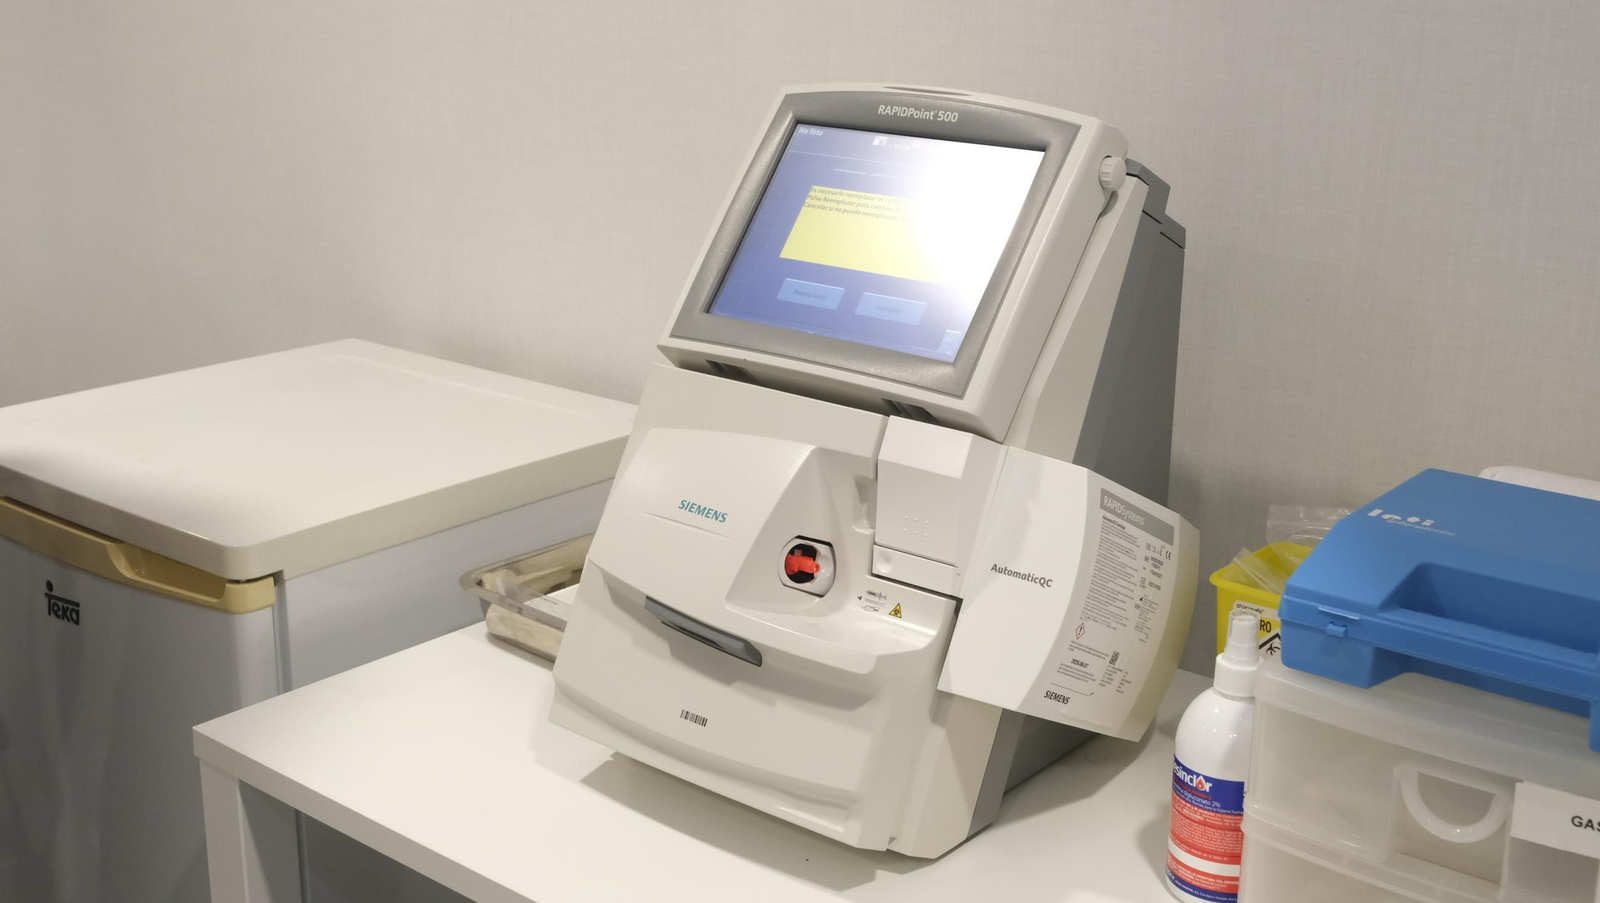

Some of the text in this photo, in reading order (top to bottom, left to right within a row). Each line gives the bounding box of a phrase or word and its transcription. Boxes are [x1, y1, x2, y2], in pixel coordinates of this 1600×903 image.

[936, 110, 959, 123] 500
[809, 128, 824, 136] listo
[817, 188, 845, 197] necesario
[844, 191, 877, 201] reemplazar
[822, 196, 855, 207] Reemplazar
[804, 202, 828, 211] Cancelar
[842, 208, 862, 216] puede
[876, 304, 904, 315] Cancelar
[678, 499, 728, 523] SIEMENS
[1103, 495, 1145, 526] RAPIDSystems
[990, 563, 1054, 589] AutomaticQC
[1260, 619, 1272, 634] RO
[1044, 690, 1071, 705] SIEMENS
